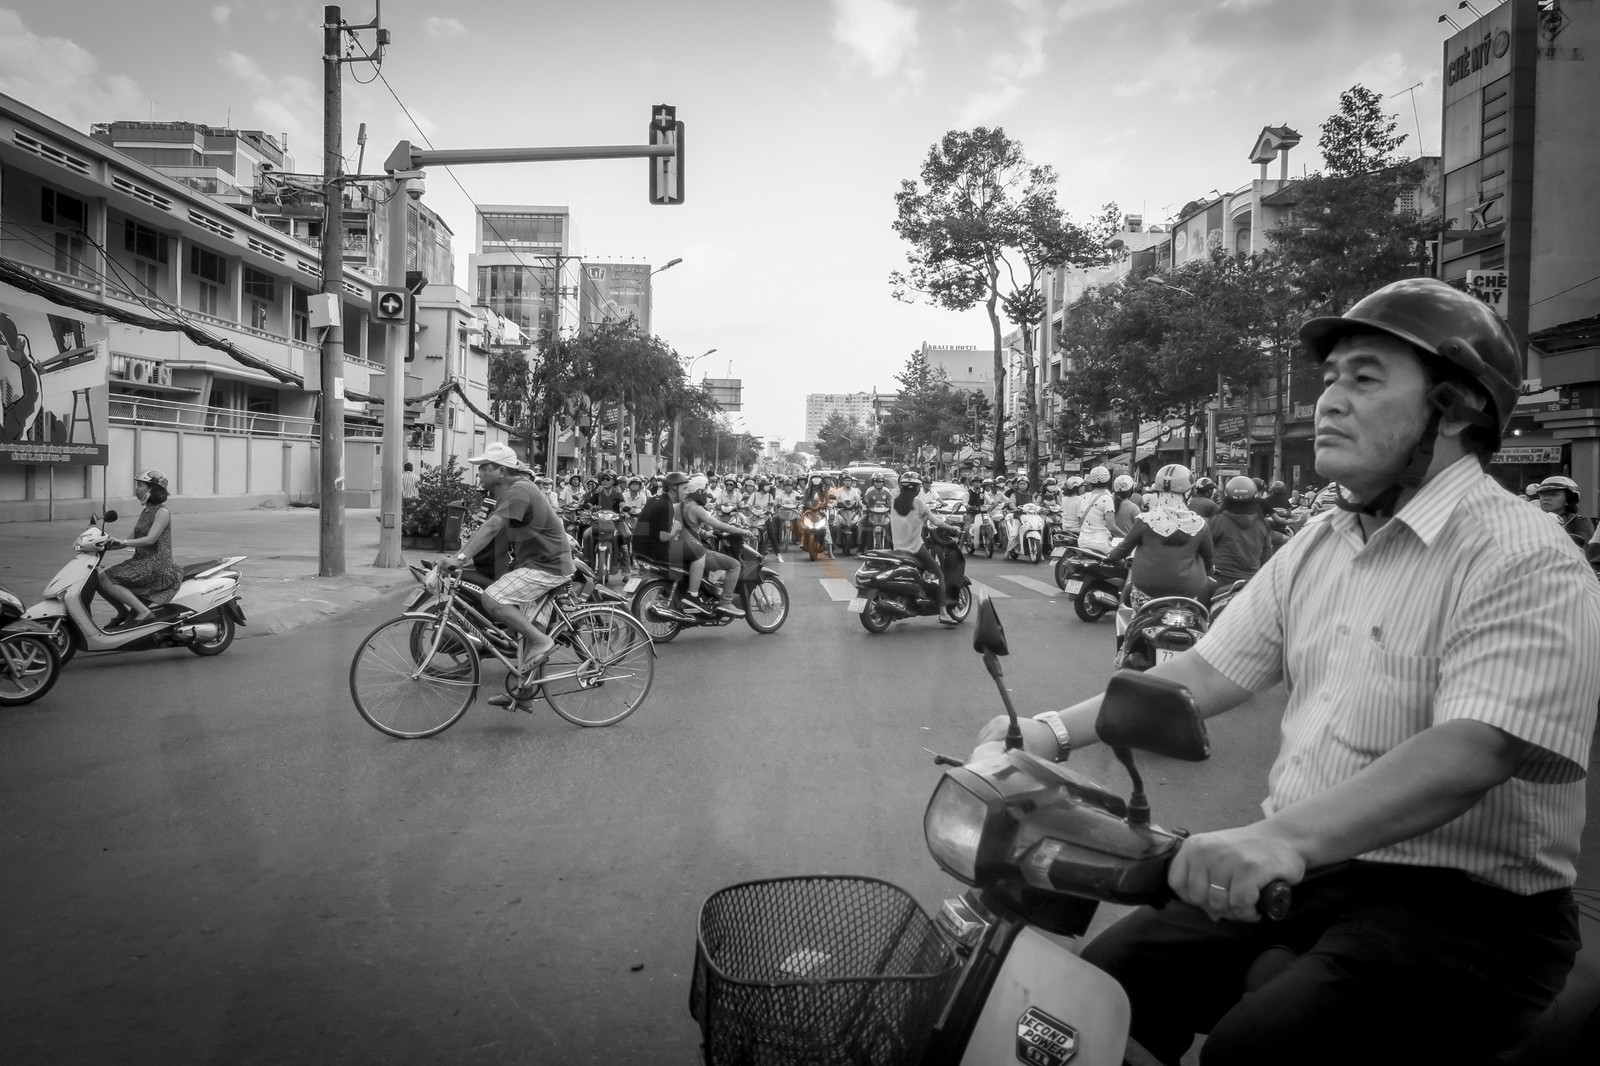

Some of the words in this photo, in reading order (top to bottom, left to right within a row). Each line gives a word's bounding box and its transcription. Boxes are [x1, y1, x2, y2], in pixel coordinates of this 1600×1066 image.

[1448, 46, 1471, 87] CHÈ
[1473, 272, 1508, 288] CHÈ
[1505, 454, 1534, 463] PHONG
[1023, 1029, 1067, 1058] POWER
[1025, 1017, 1068, 1045] ECONO
